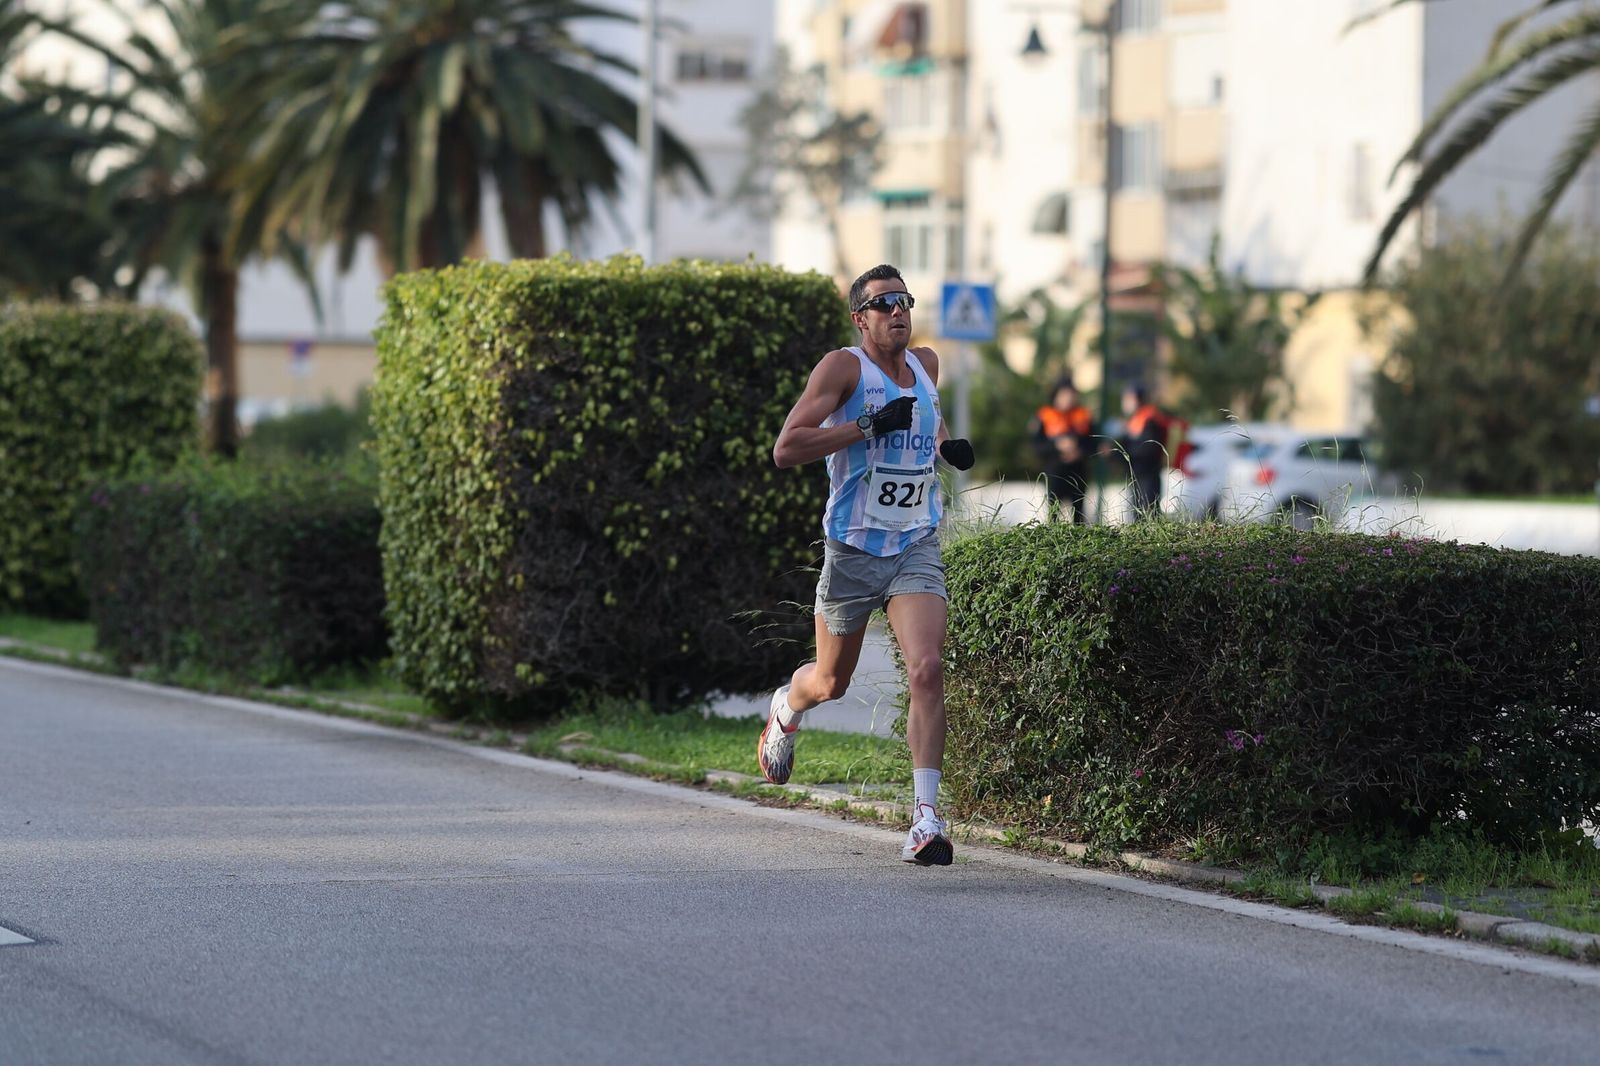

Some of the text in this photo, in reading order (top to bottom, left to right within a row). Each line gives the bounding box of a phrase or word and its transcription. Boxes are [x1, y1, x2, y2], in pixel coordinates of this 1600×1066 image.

[866, 387, 885, 395] vive
[866, 430, 936, 457] malag
[878, 481, 925, 508] 821
